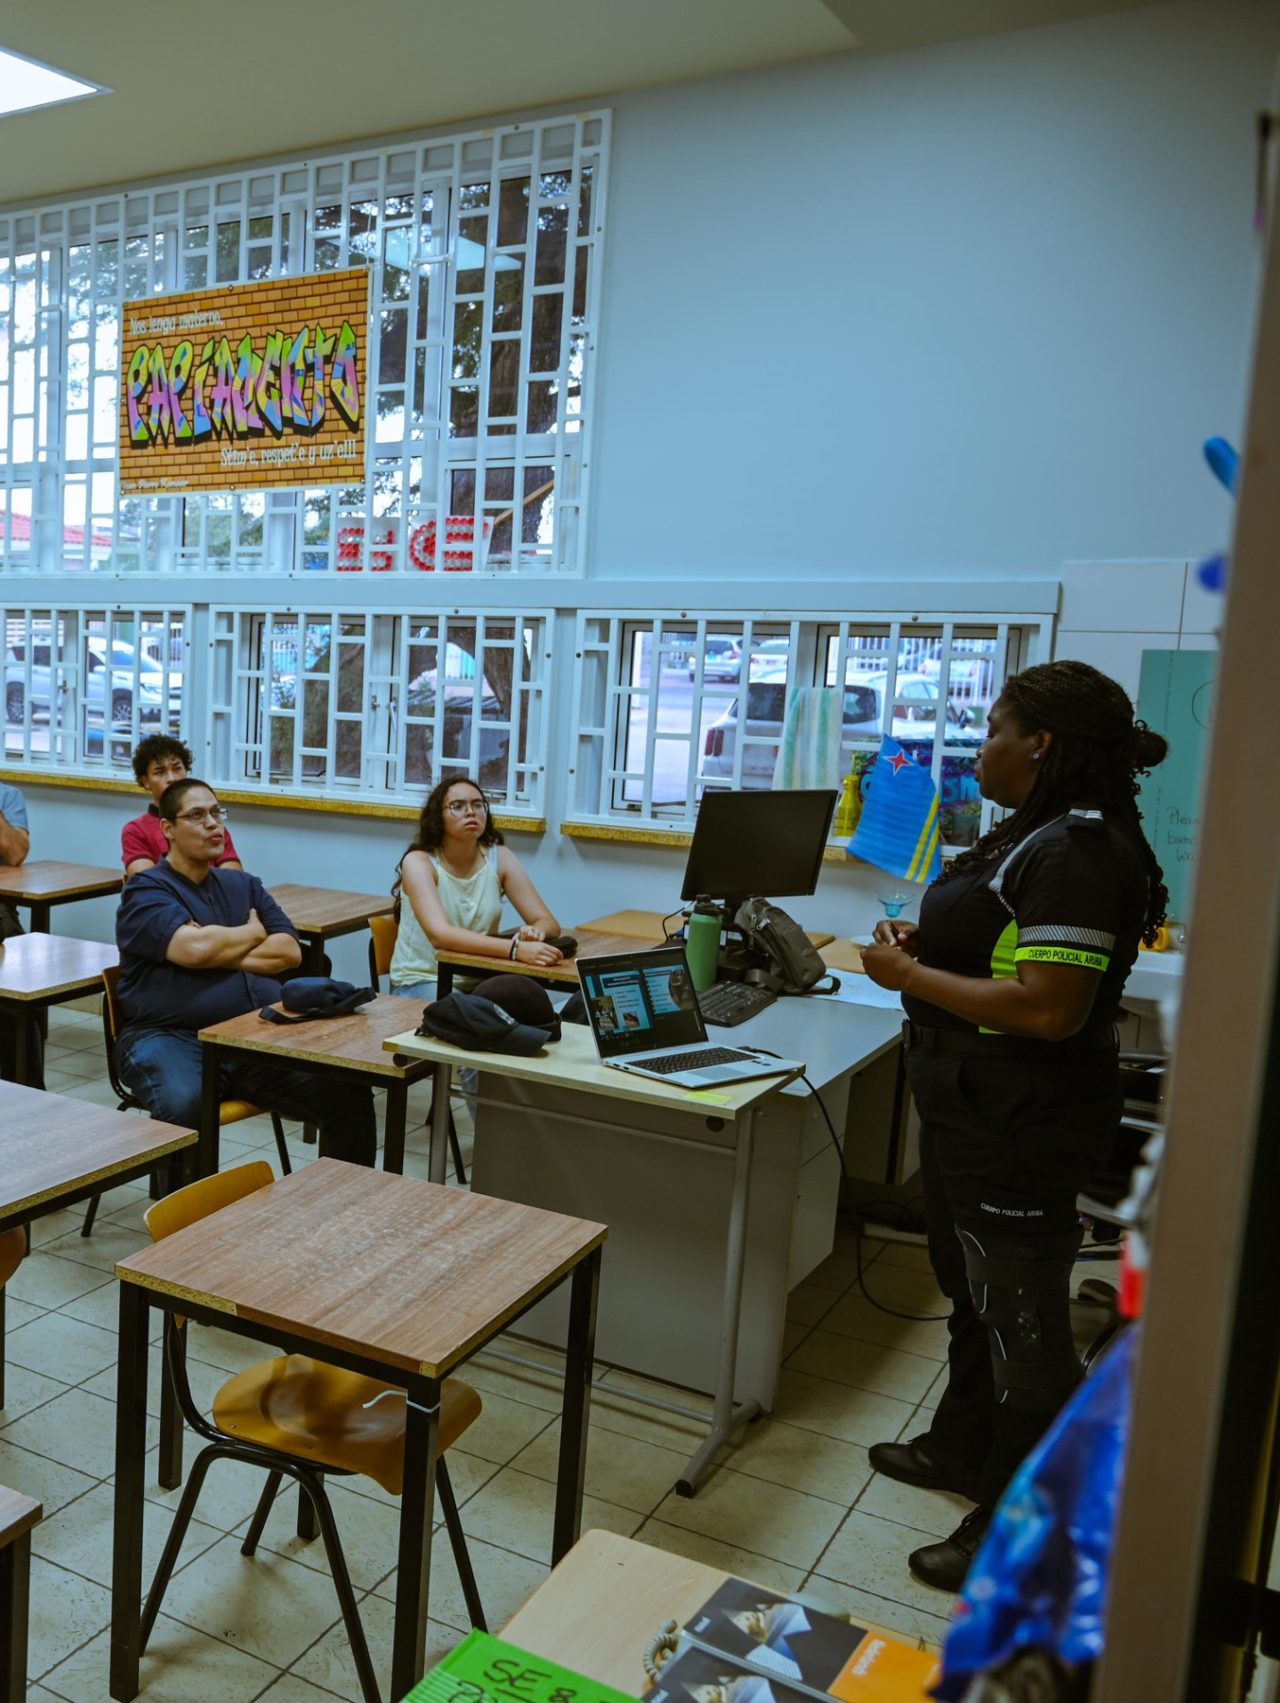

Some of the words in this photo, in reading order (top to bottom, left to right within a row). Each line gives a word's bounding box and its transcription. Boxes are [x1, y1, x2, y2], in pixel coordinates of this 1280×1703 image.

[129, 317, 147, 335] Nos
[1028, 949, 1052, 959] CUERPO
[1053, 950, 1082, 964] POLICIAL
[1084, 954, 1102, 966] ARUBA
[980, 1202, 1001, 1214] CUERPO
[1002, 1209, 1025, 1217] POLICIAL
